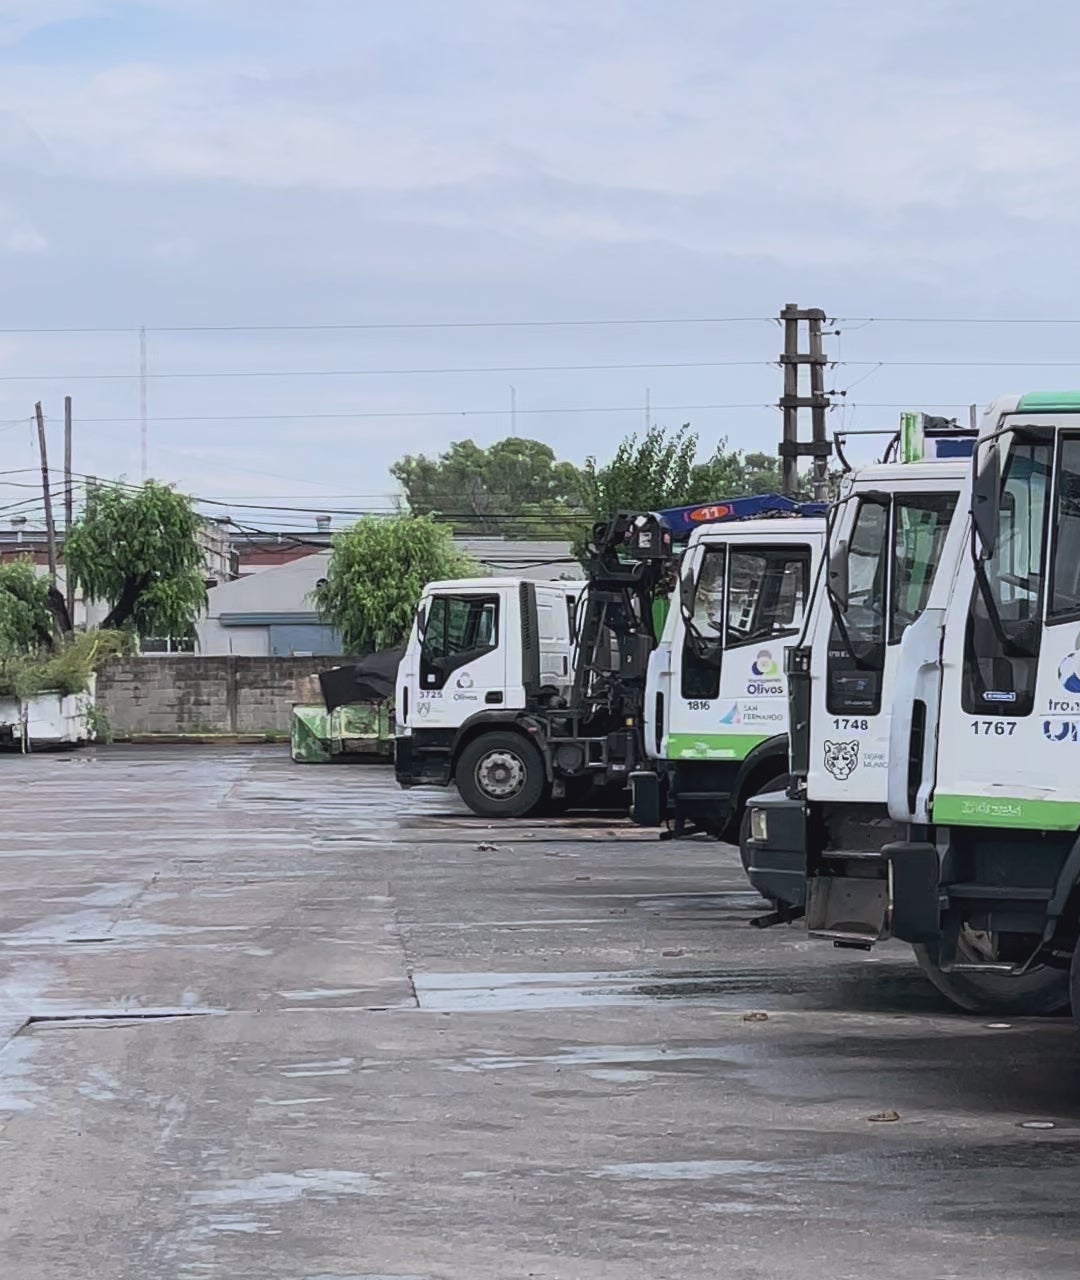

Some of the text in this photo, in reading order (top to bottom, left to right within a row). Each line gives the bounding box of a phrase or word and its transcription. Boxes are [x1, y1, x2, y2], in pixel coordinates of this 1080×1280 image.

[701, 507, 720, 519] 11
[746, 683, 784, 695] Olivos
[687, 701, 711, 711] 1816
[833, 718, 869, 731] 1748
[971, 720, 1018, 736] 1767
